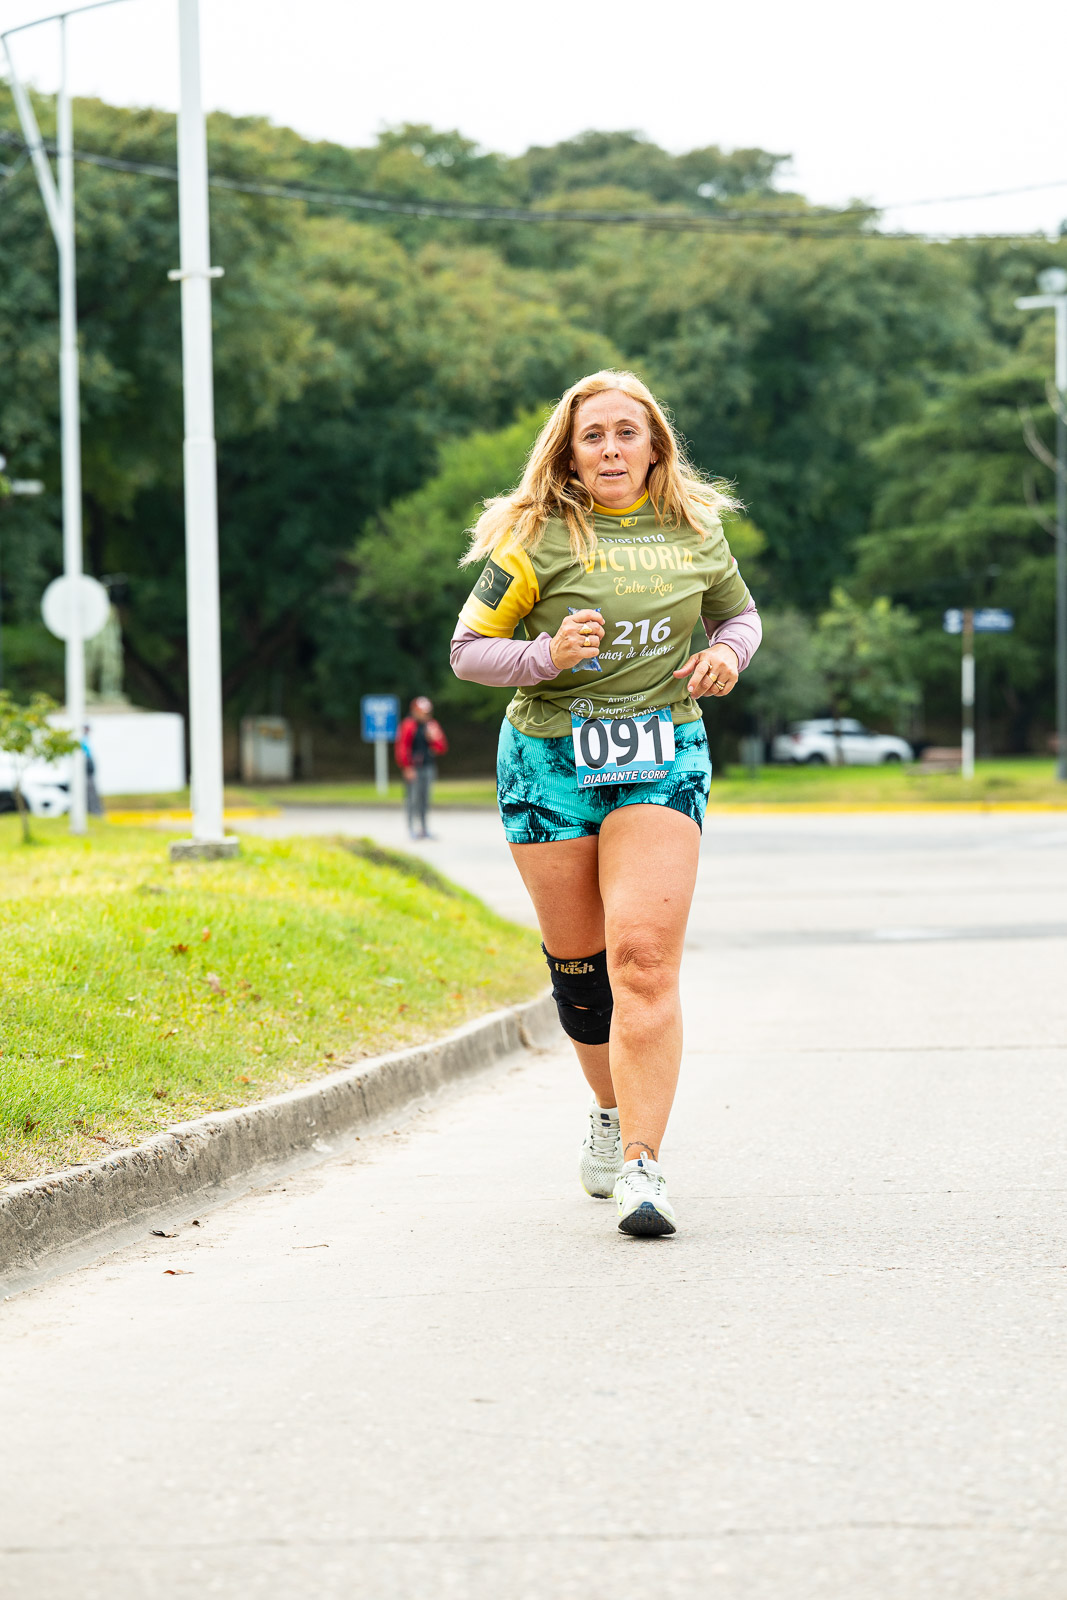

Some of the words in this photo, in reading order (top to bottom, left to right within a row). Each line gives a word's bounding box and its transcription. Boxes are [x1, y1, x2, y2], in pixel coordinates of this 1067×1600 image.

[578, 545, 697, 574] VICTORIA
[613, 576, 647, 596] Entre
[611, 616, 671, 646] 216
[598, 649, 624, 661] años
[626, 646, 638, 659] de
[580, 714, 664, 770] 091
[583, 770, 639, 785] DIAMANTE
